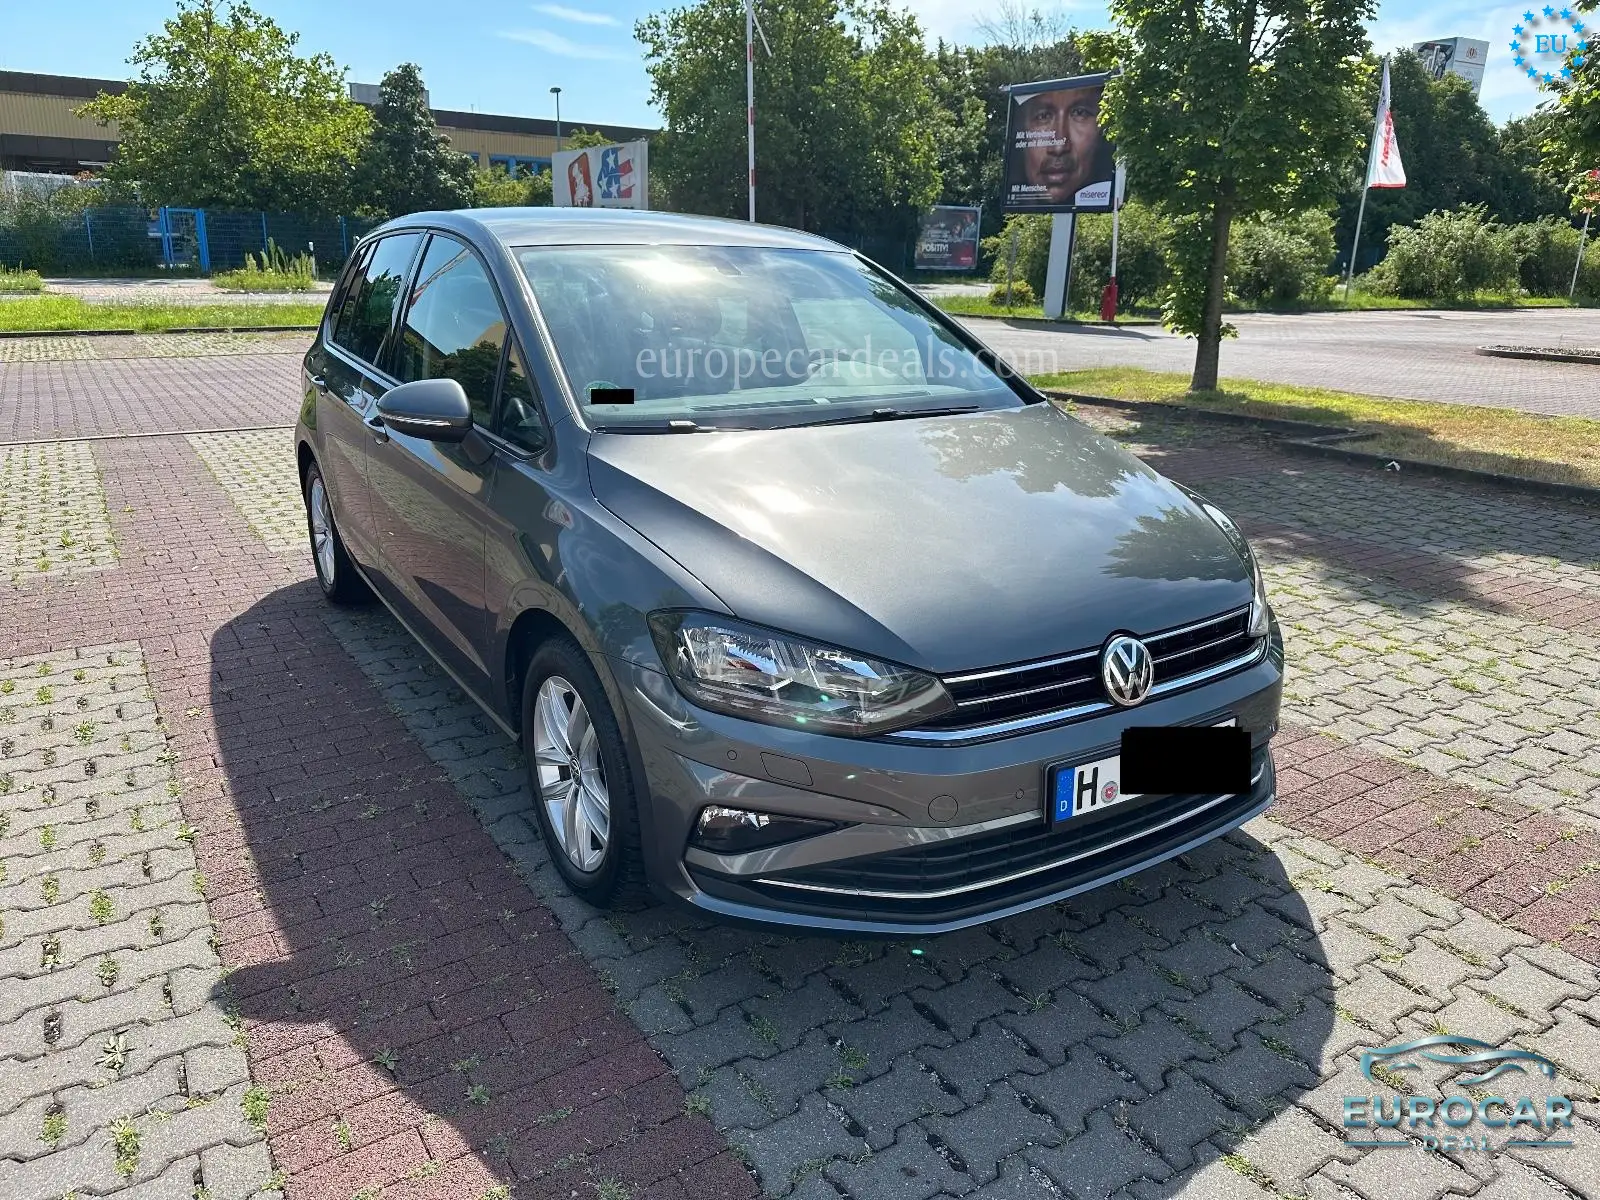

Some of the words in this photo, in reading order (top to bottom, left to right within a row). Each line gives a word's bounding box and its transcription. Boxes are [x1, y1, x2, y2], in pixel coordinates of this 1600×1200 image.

[1015, 141, 1027, 149] oder
[1028, 140, 1036, 148] mit
[1037, 137, 1067, 147] Menschen?
[1012, 184, 1020, 192] Mit
[1021, 184, 1047, 192] Menschen.
[1080, 190, 1108, 199] misereor
[1060, 800, 1068, 812] D
